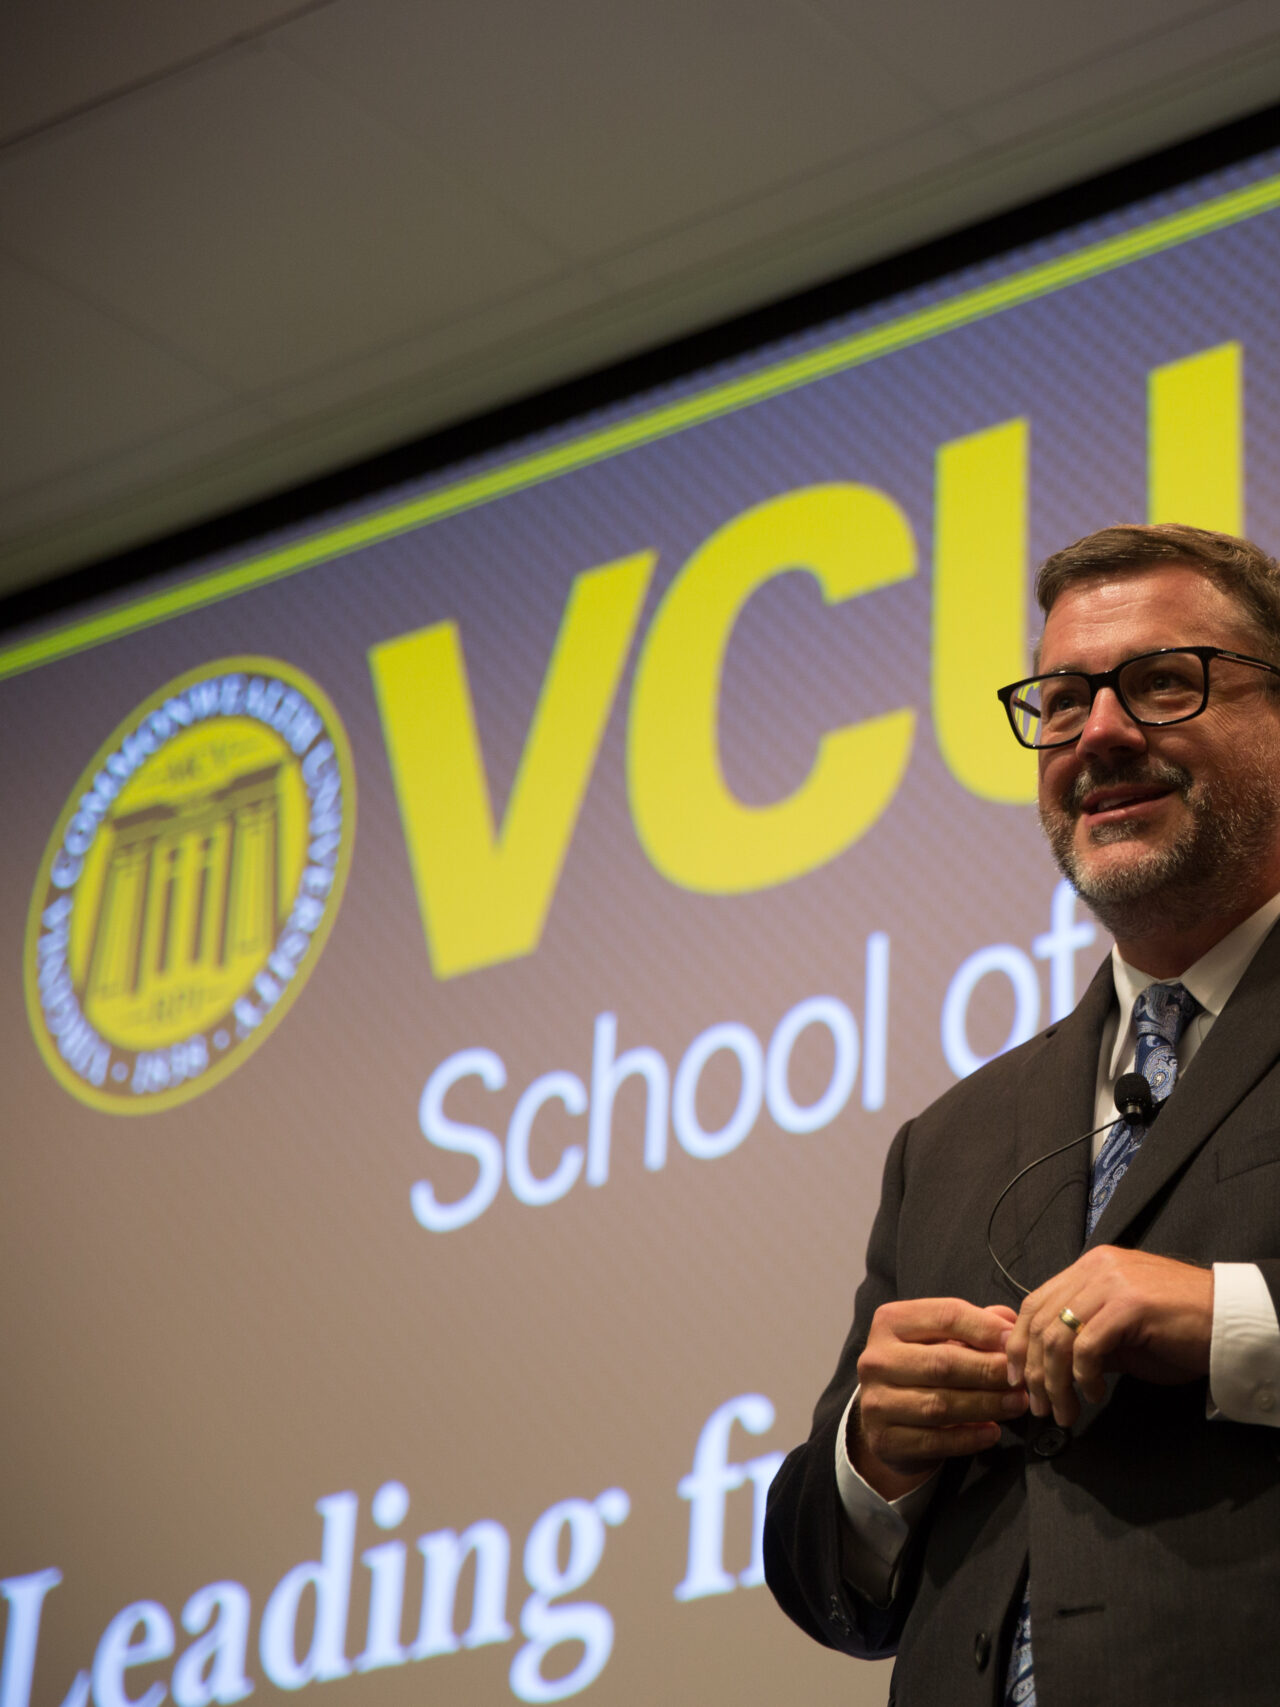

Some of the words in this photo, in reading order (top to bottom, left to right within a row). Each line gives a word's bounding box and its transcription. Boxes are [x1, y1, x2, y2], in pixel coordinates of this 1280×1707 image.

[367, 341, 1242, 982] VCU
[410, 931, 891, 1233] School
[940, 877, 1097, 1079] of
[0, 1479, 631, 1707] Leading
